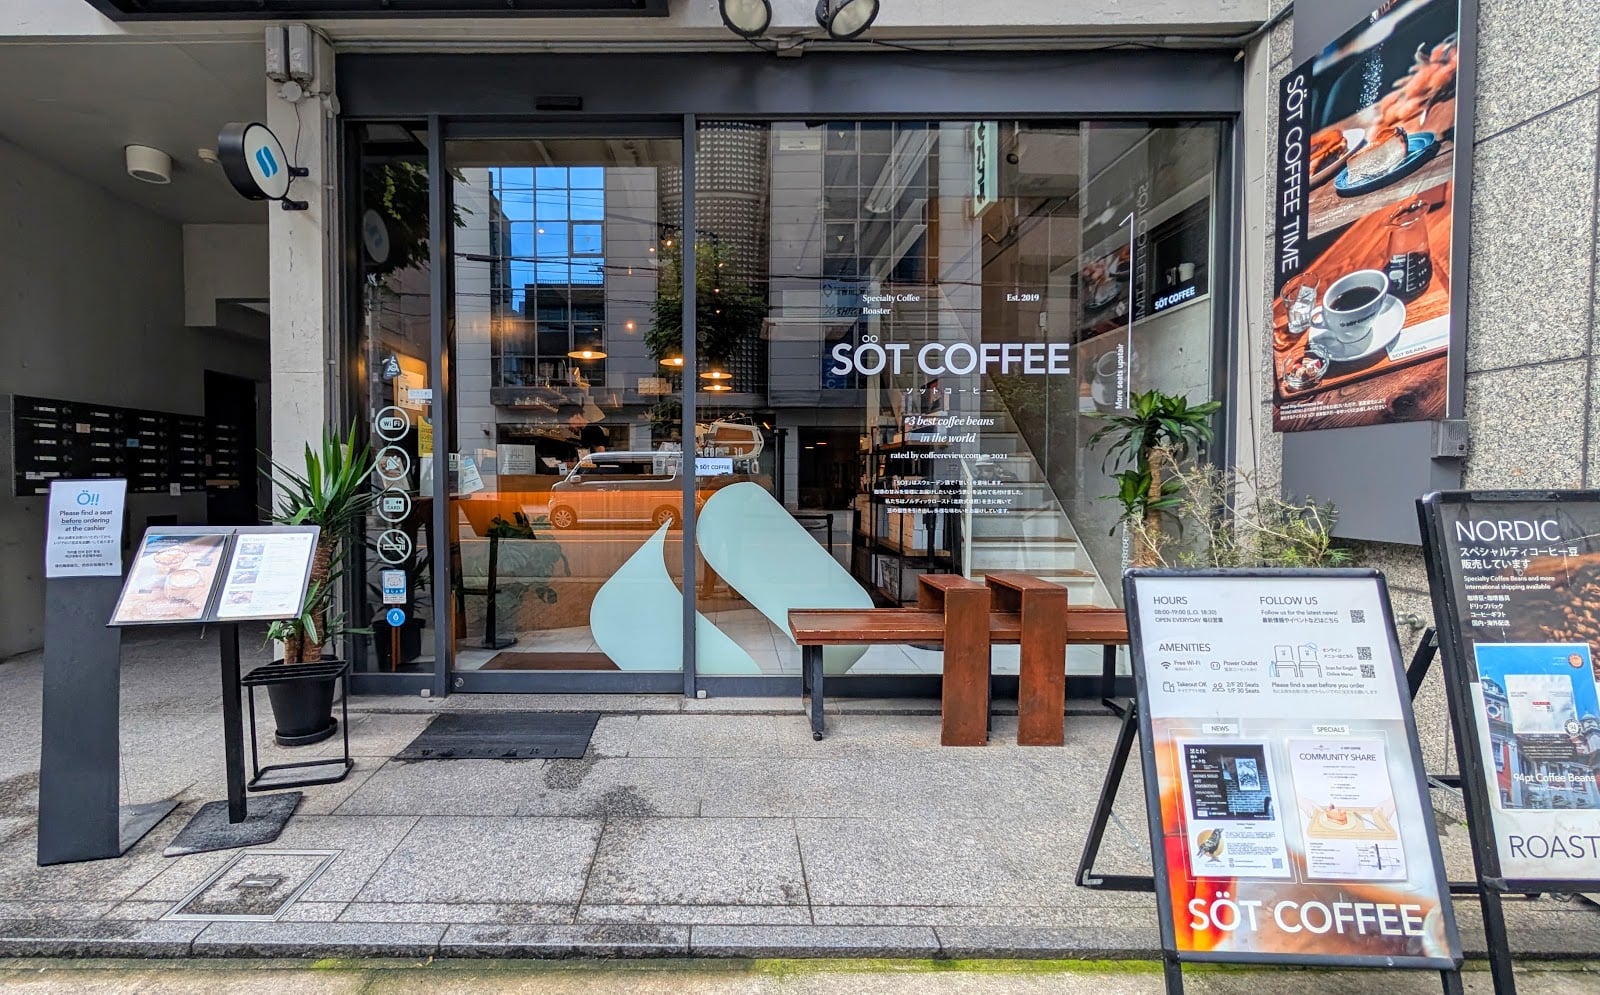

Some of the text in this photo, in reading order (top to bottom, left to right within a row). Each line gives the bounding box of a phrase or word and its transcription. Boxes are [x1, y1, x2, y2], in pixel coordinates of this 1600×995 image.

[1282, 75, 1307, 273] SÖT COFFEE TIME
[862, 294, 895, 304] Specialty
[1154, 286, 1195, 310] SÖT COFFEE
[831, 334, 910, 375] SÖT
[918, 342, 1070, 375] COFFEE
[1116, 344, 1125, 368] upstair
[904, 416, 994, 428] #3 best coffee beans
[920, 433, 976, 443] in the world
[911, 452, 919, 460] by
[77, 490, 100, 505] Ö!!
[1455, 520, 1560, 541] NORDIC
[1460, 546, 1579, 557] スペシャルティコーヒー豆
[1462, 559, 1530, 569] 販売しています
[1153, 596, 1188, 604] HOURS
[1260, 596, 1318, 605] FOLLOW US
[1159, 643, 1211, 652] AMENITIES
[1513, 773, 1595, 784] 94pt Coffee Beans
[1509, 835, 1600, 858] ROAST
[1188, 891, 1426, 936] SÖT COFFEE
